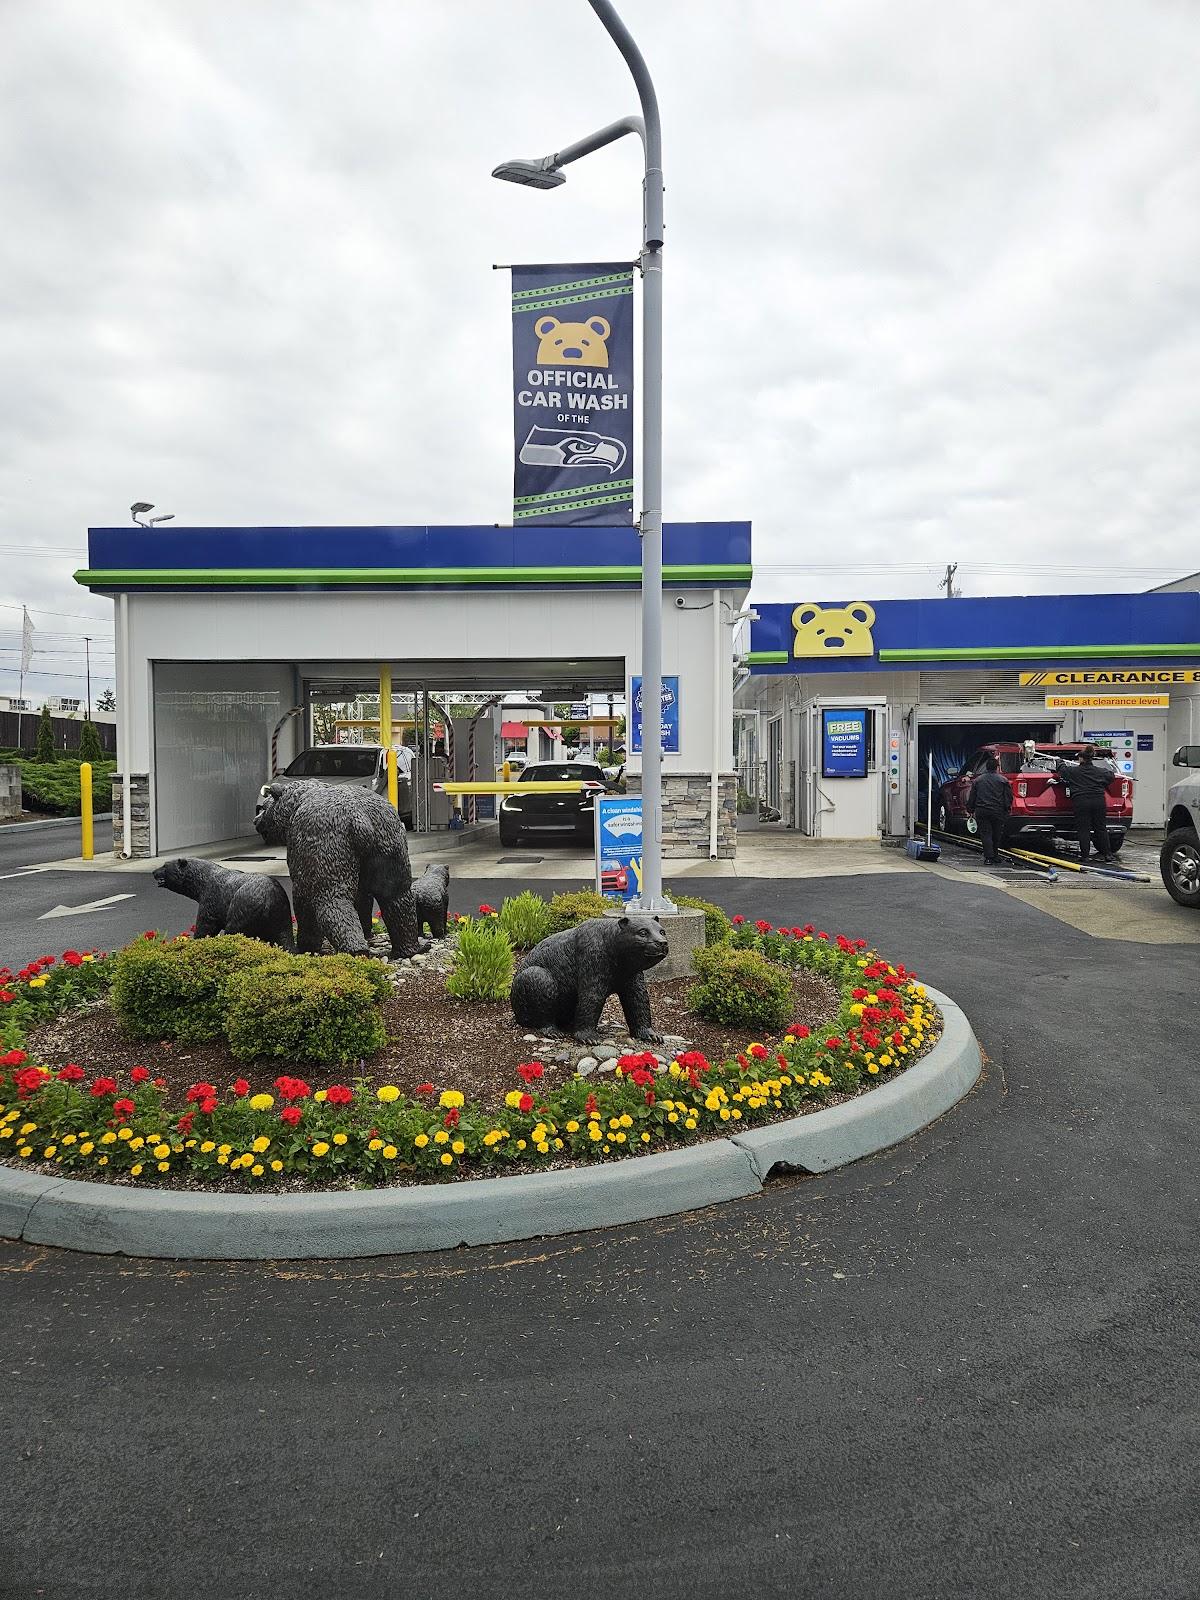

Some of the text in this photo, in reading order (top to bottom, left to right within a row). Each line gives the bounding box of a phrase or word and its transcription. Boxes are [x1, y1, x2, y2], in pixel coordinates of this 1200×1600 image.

[527, 369, 619, 390] OFFICIAL
[518, 390, 628, 411] CAR WASH
[557, 413, 590, 424] OF THE
[1055, 672, 1185, 684] CLEARANCE
[1053, 698, 1069, 706] Bar
[1071, 698, 1080, 706] is
[1082, 698, 1091, 706] at
[1139, 697, 1161, 705] level
[830, 721, 861, 733] FREE
[830, 734, 860, 742] VACUUMS
